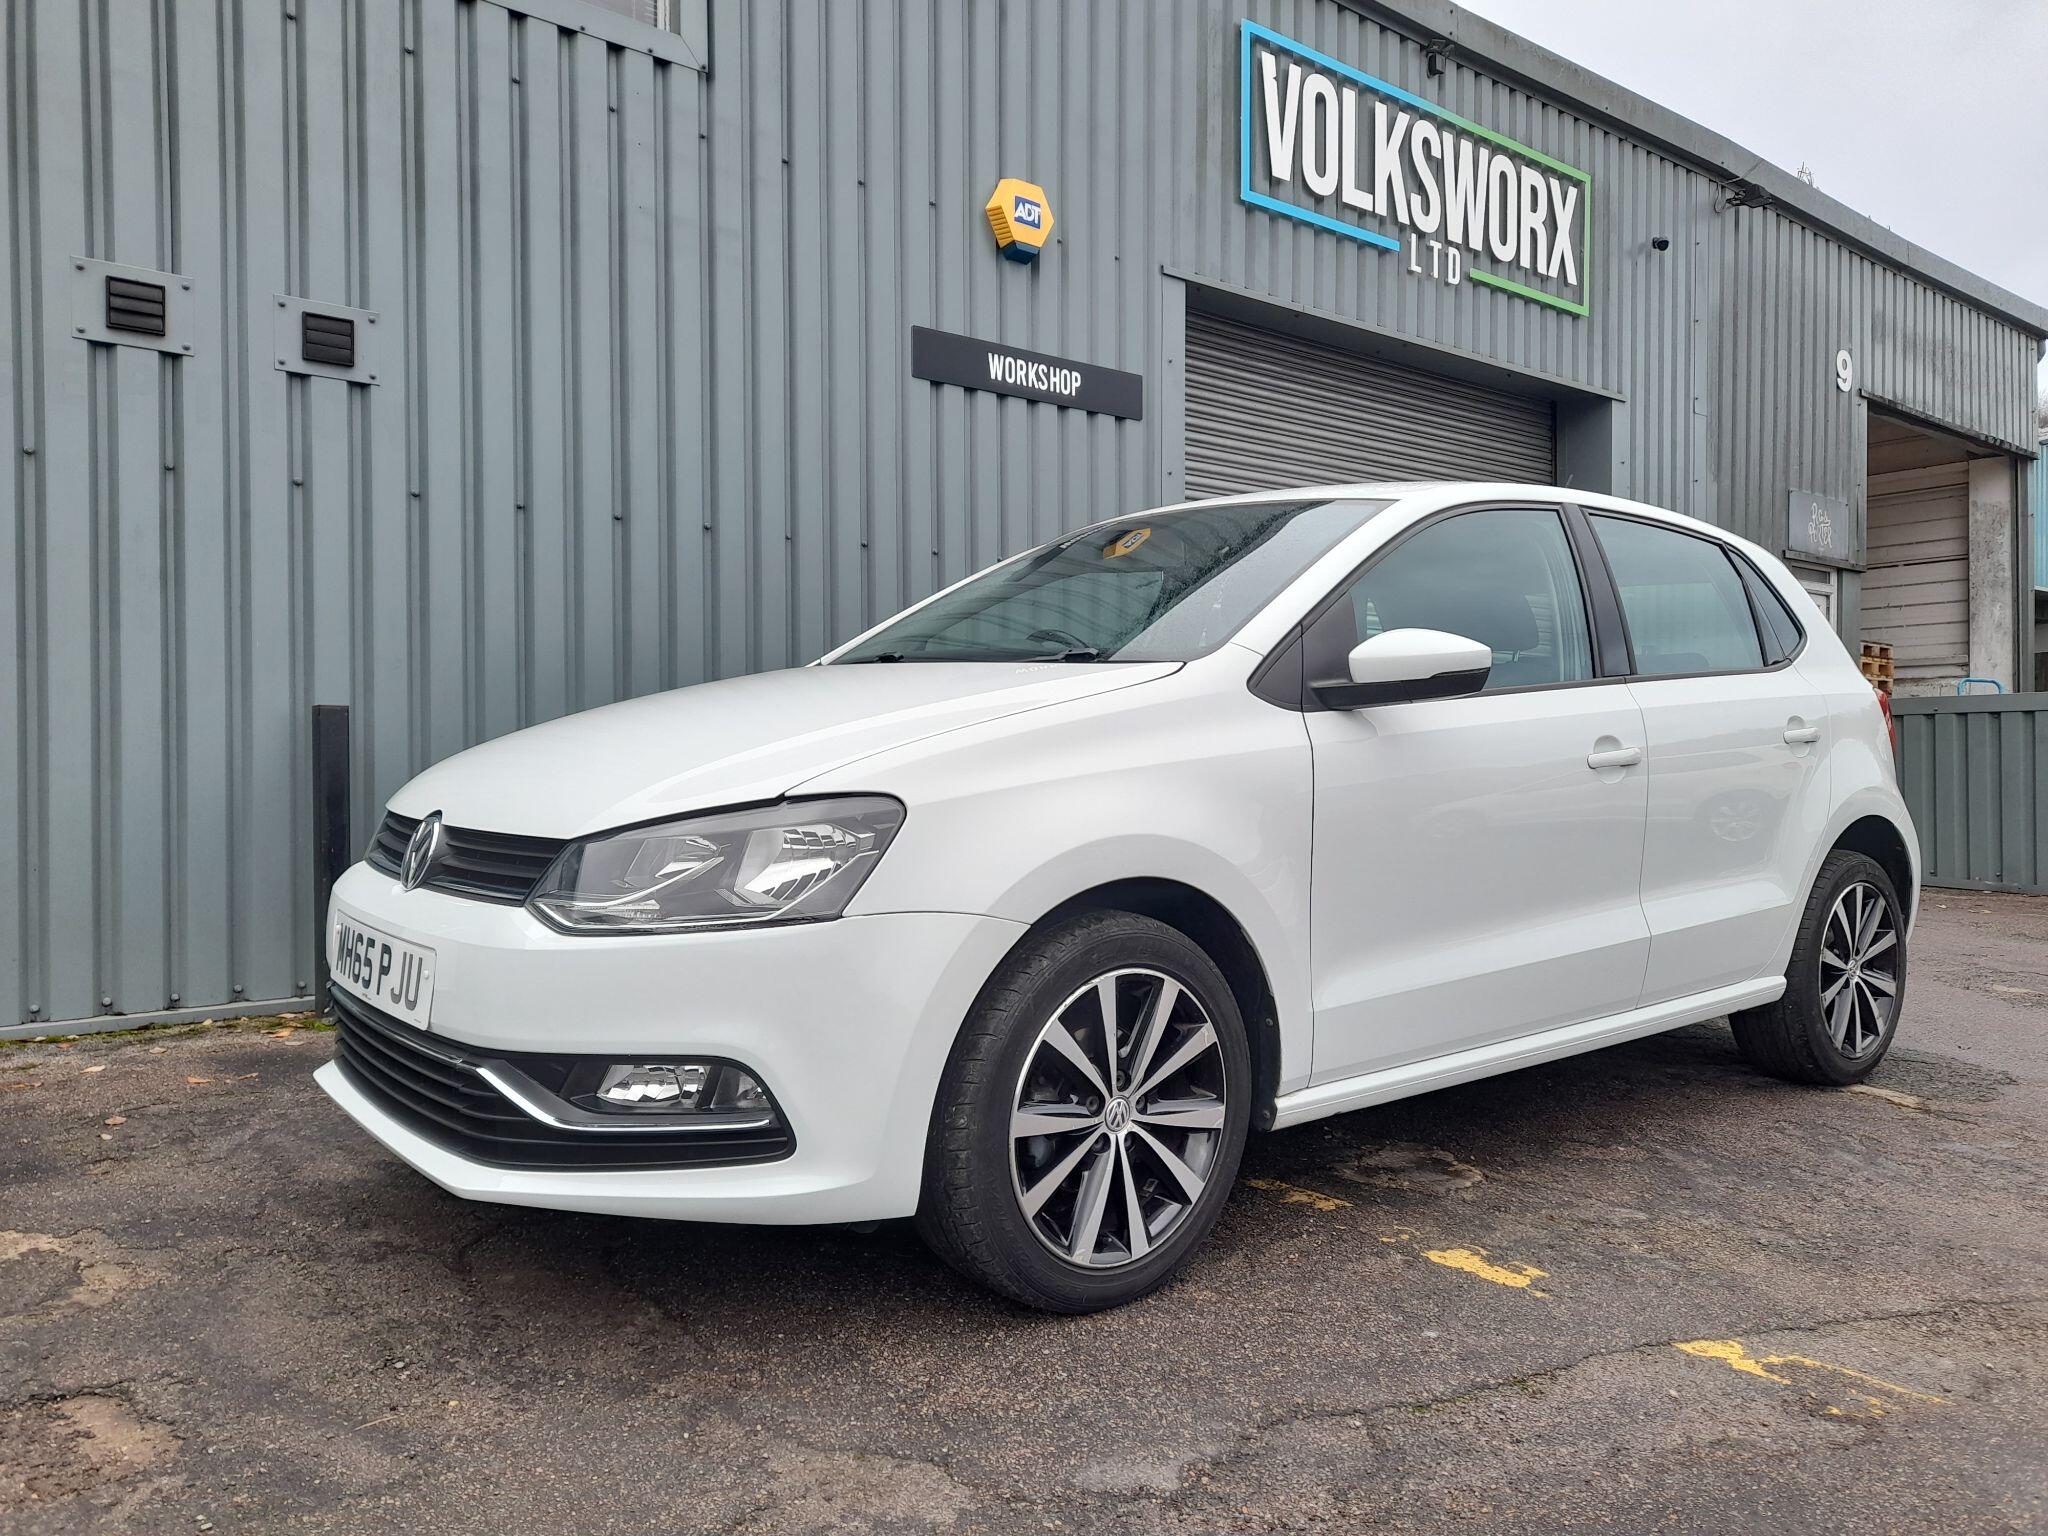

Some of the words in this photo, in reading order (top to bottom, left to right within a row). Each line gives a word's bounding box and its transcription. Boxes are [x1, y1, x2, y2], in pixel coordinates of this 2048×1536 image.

[1261, 50, 1578, 286] VOLKSWORX
[1014, 201, 1041, 225] ADT
[1410, 233, 1461, 285] LTD
[987, 352, 1081, 397] WORKSHOP
[1836, 349, 1853, 392] 9
[376, 942, 423, 1011] PJU
